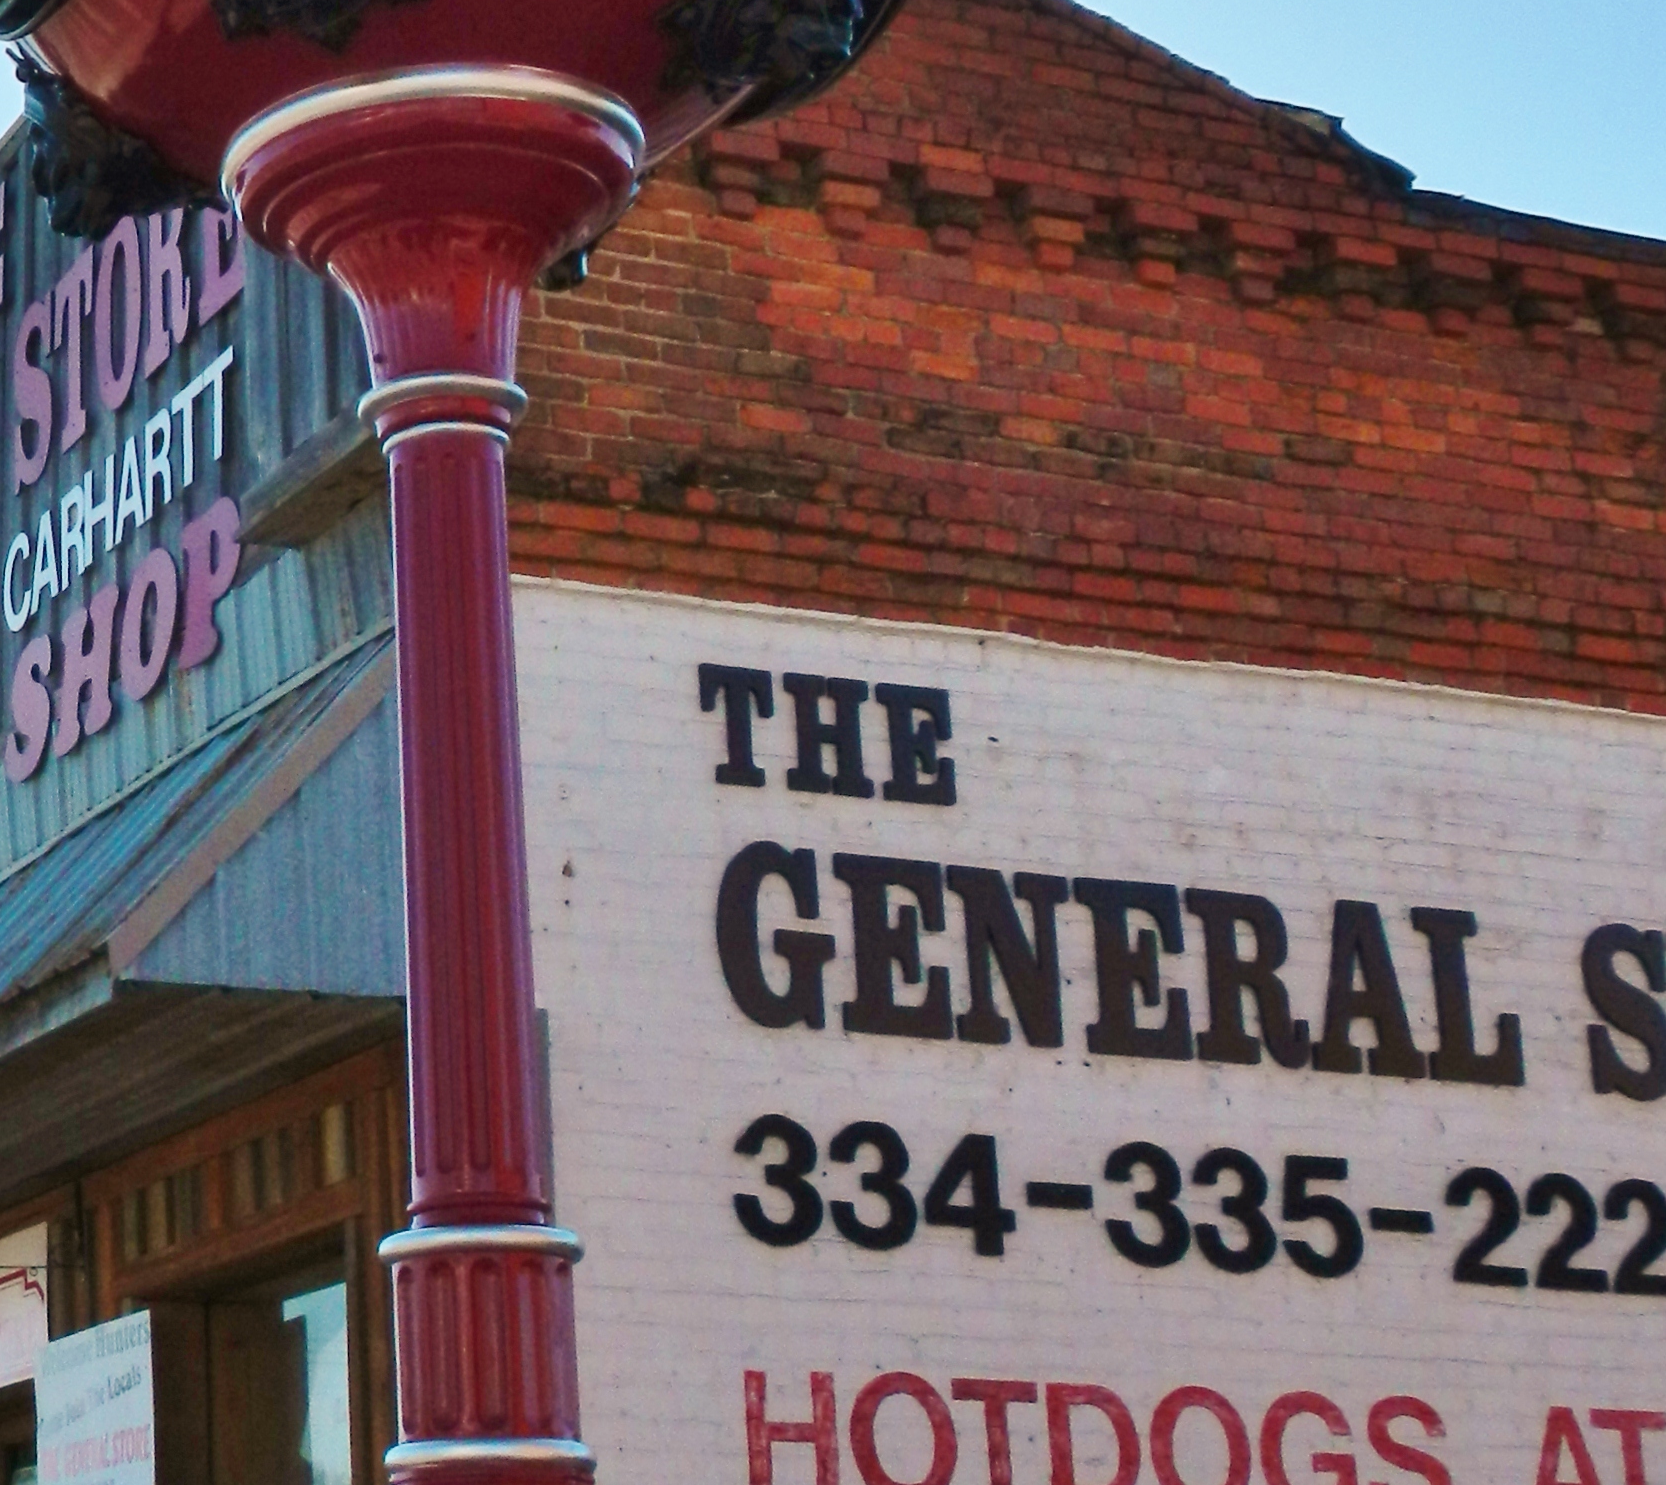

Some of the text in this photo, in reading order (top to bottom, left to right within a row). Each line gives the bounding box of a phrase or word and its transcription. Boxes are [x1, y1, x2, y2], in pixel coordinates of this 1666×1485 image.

[2, 345, 235, 634] CARHARTT
[15, 205, 246, 497] STORE
[4, 496, 242, 784] SHOP
[698, 662, 957, 807] THE
[716, 840, 1527, 1088] GENERAL
